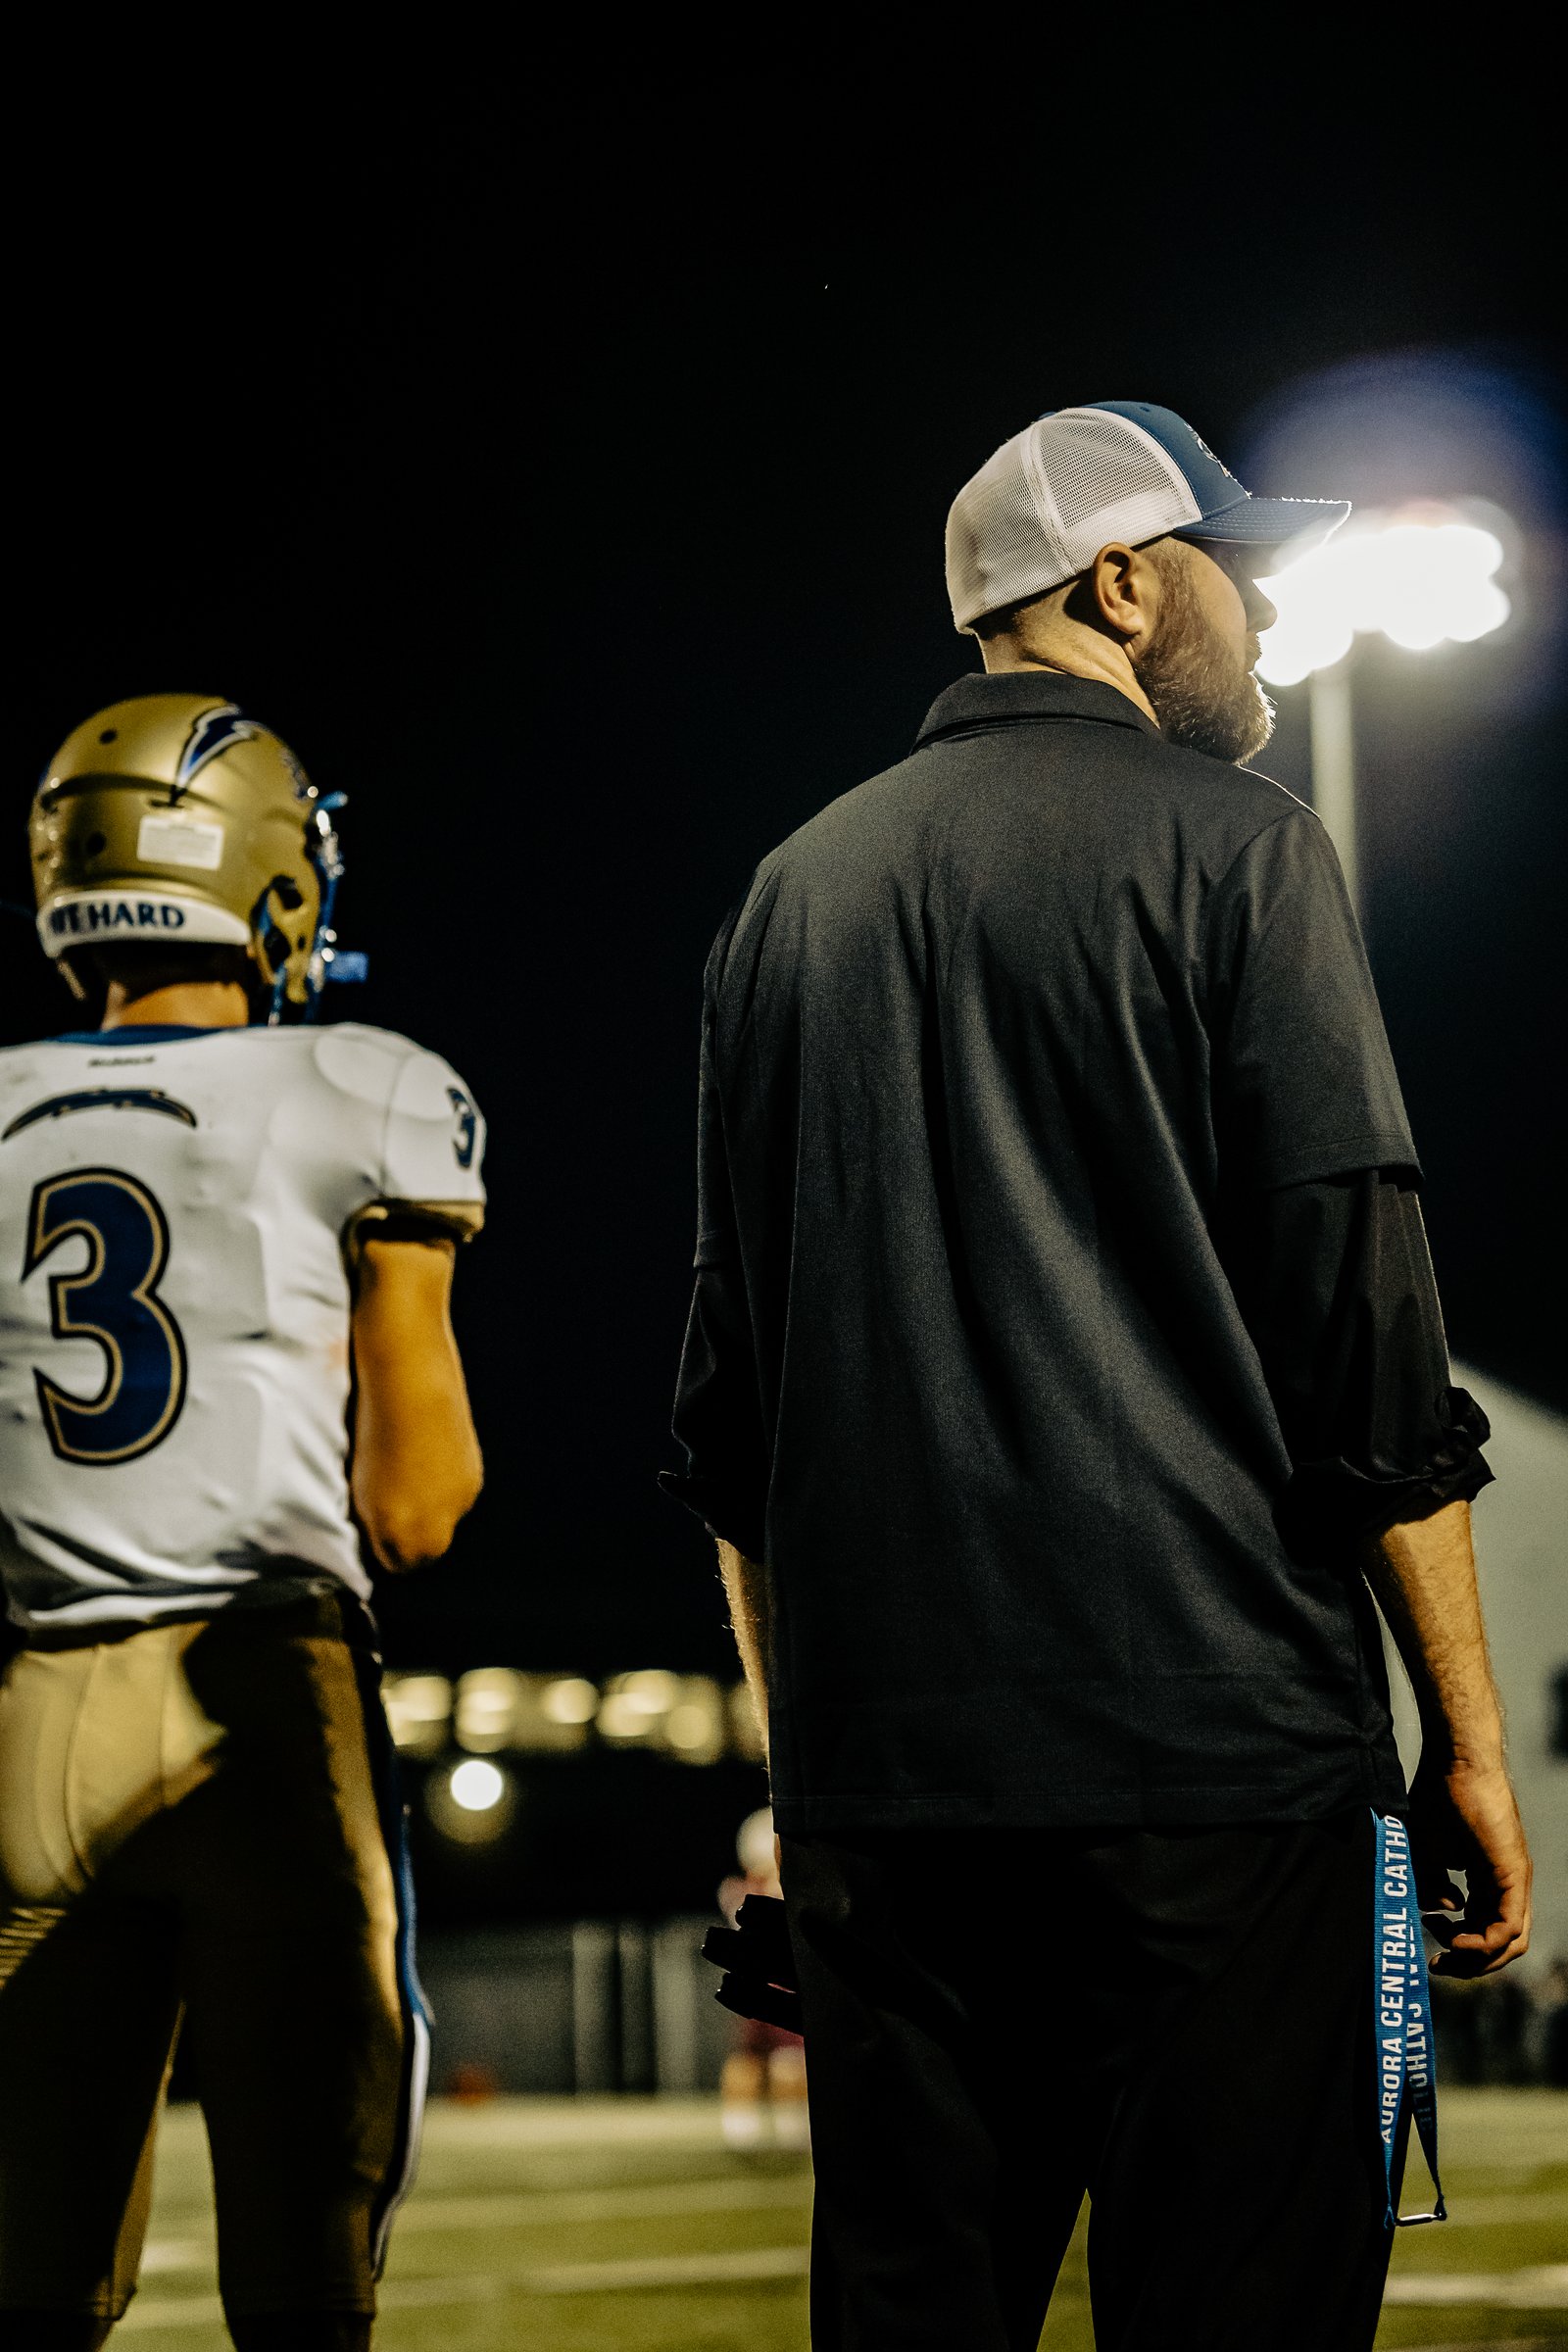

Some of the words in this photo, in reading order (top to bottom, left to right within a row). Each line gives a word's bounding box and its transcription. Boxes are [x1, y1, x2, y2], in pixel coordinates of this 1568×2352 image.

[87, 902, 185, 930] HARD
[446, 1086, 475, 1170] 3
[21, 1166, 188, 1466] 3
[1380, 1907, 1407, 2028] CENTRAL
[1380, 2035, 1402, 2144] AURORA
